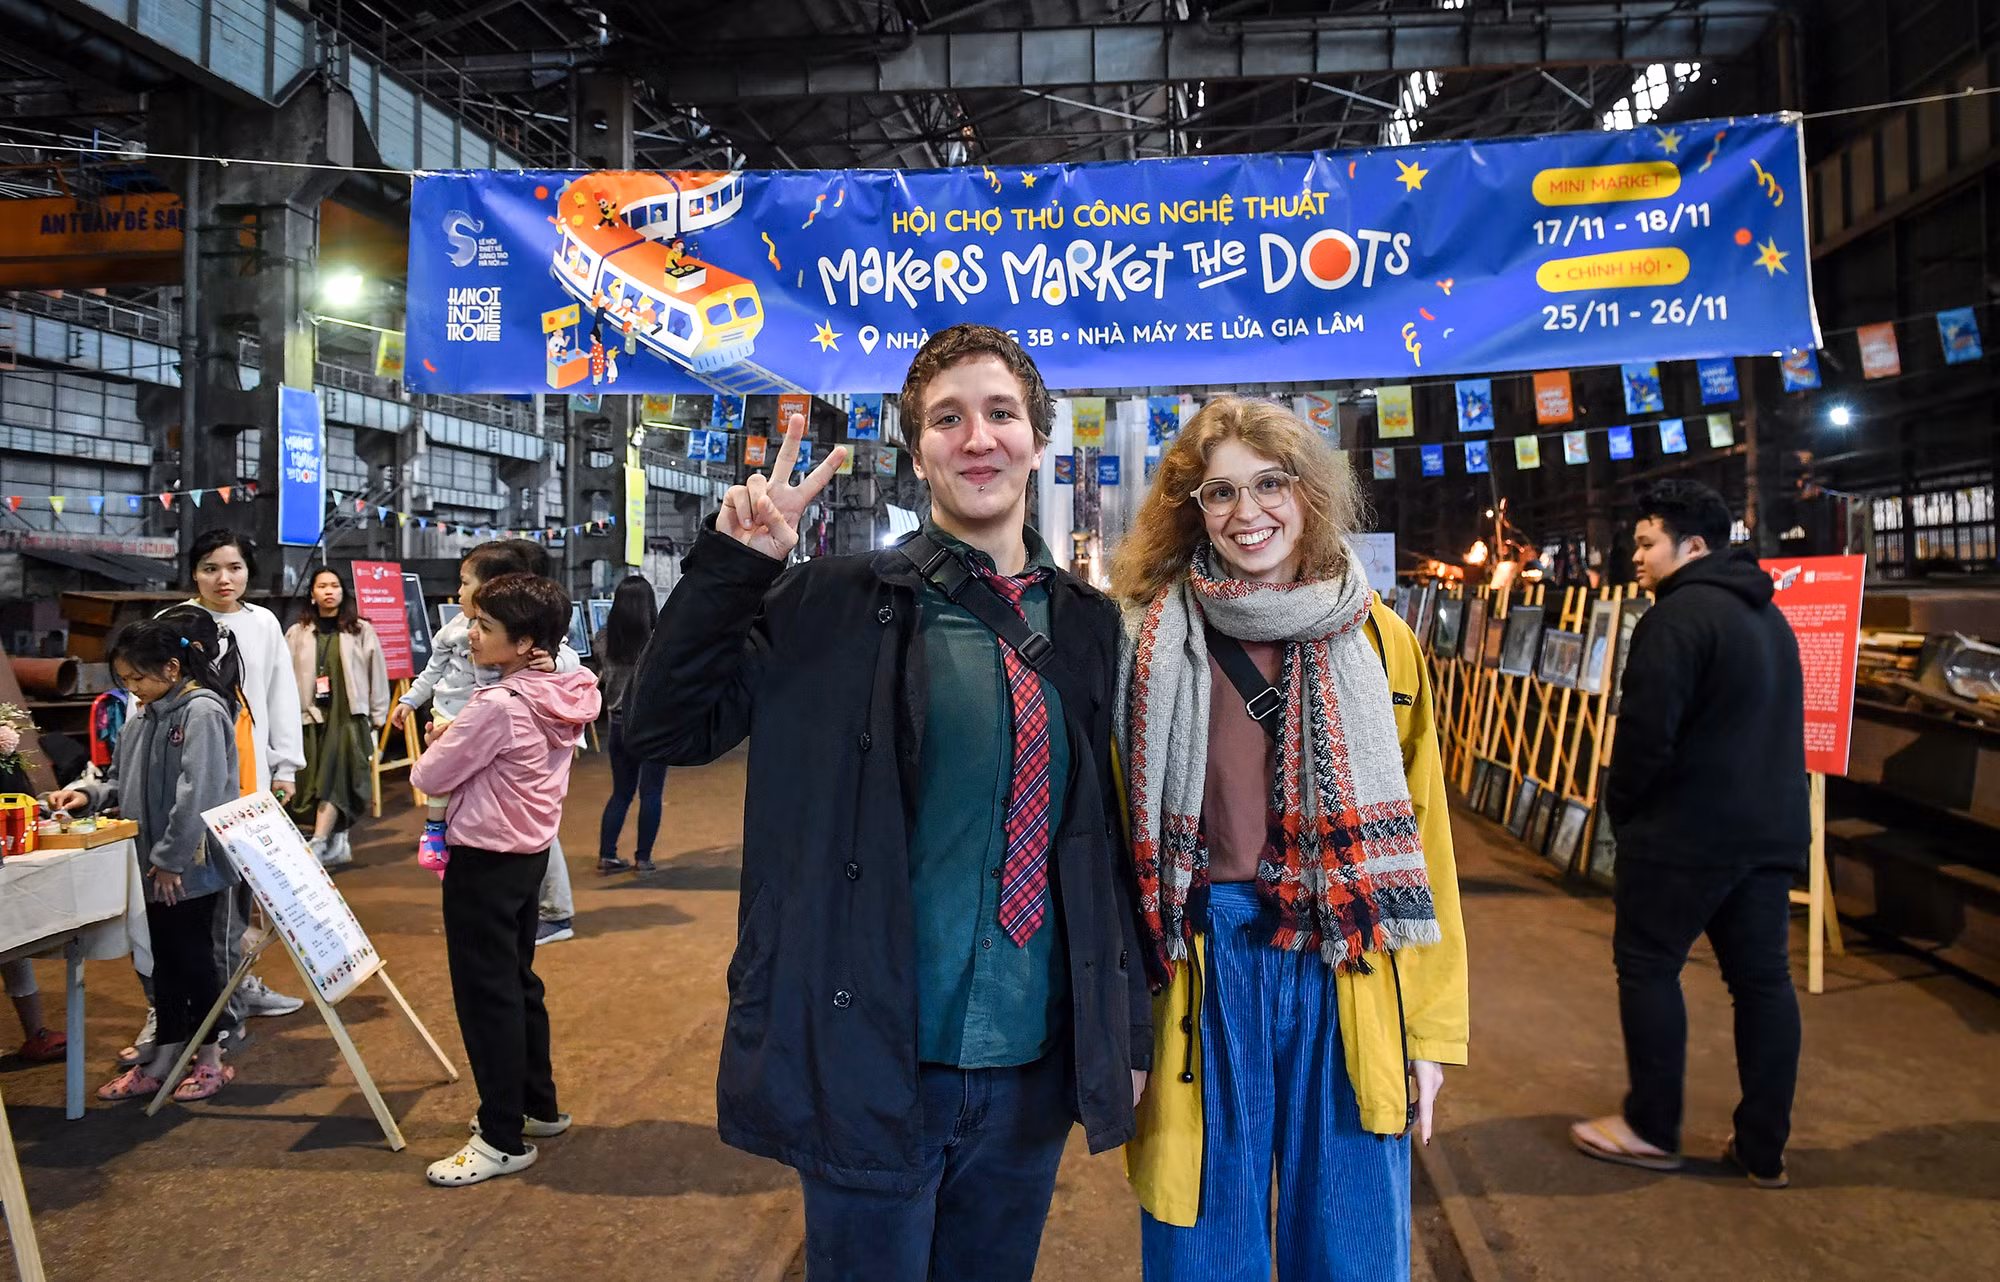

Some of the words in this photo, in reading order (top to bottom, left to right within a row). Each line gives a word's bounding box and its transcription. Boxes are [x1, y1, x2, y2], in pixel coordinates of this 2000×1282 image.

[1550, 179, 1585, 193] MINI
[1591, 172, 1661, 192] MARKET
[892, 205, 936, 236] HỘI
[945, 206, 1002, 236] CHỢ
[1010, 200, 1064, 231] THỦ
[1073, 199, 1151, 227] CÔNG
[1159, 193, 1234, 226] NGHỆ
[1242, 188, 1330, 220] THUẬT
[1533, 215, 1605, 247] 17/11
[1634, 202, 1710, 234] 18/11
[1259, 228, 1411, 294] DOTS
[1567, 262, 1624, 280] CHÍNH
[1630, 257, 1661, 276] HỘI
[447, 287, 501, 306] HANOI
[1542, 300, 1619, 333] 25/11
[1651, 293, 1727, 326] 26/11
[886, 328, 930, 349] NHÀ
[1027, 328, 1054, 347] 3B
[1078, 321, 1125, 345] NHÀ
[1133, 320, 1177, 343] MÁY
[1186, 322, 1213, 341] XE
[1221, 315, 1264, 340] LỬA
[1271, 318, 1310, 337] GIA
[1317, 311, 1364, 335] LÂM
